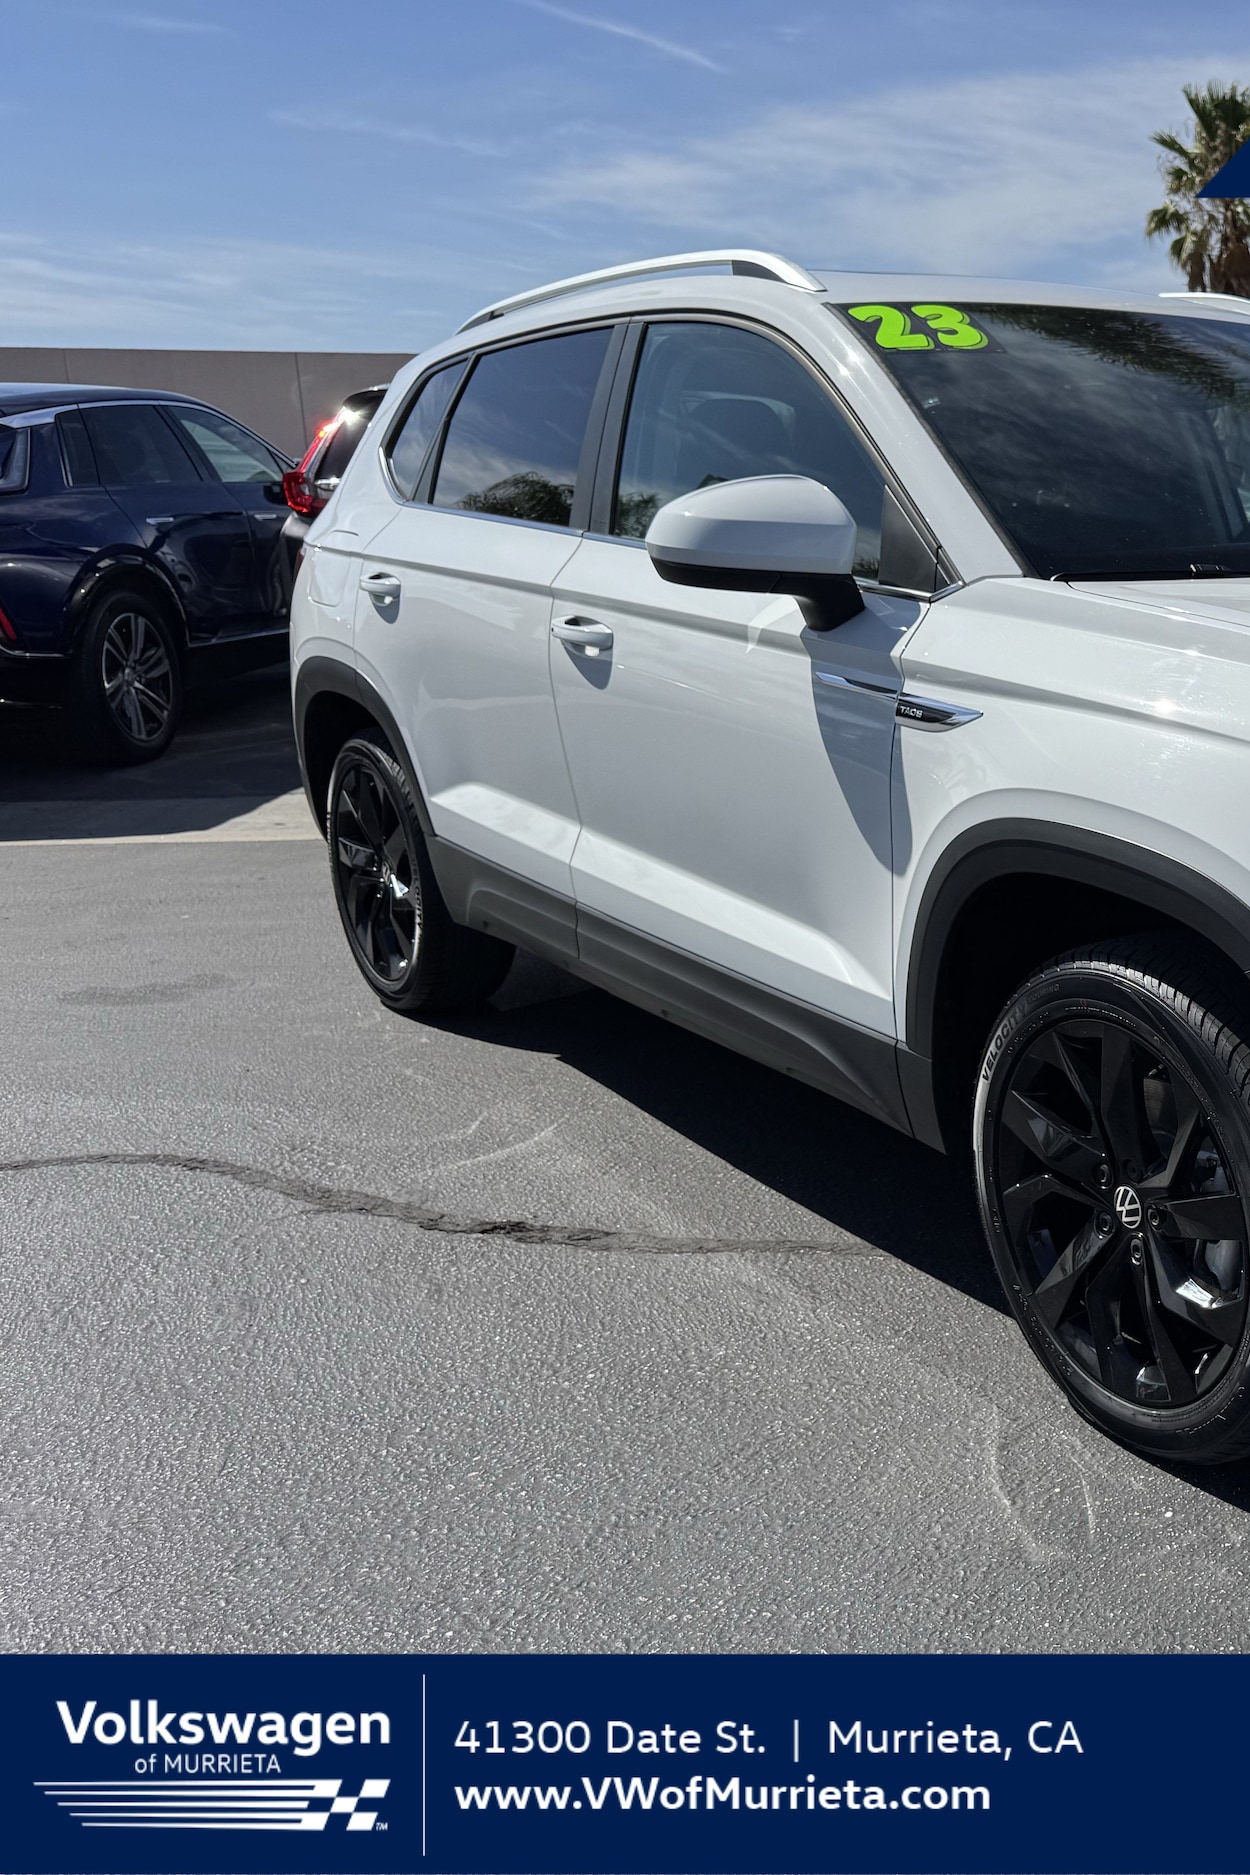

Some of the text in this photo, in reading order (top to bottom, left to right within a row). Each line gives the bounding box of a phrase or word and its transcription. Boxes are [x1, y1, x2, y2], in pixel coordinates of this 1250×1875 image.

[848, 304, 988, 350] 23
[900, 705, 923, 718] TAOS
[982, 997, 1029, 1083] VELOCITY
[1029, 983, 1060, 1003] TOURING
